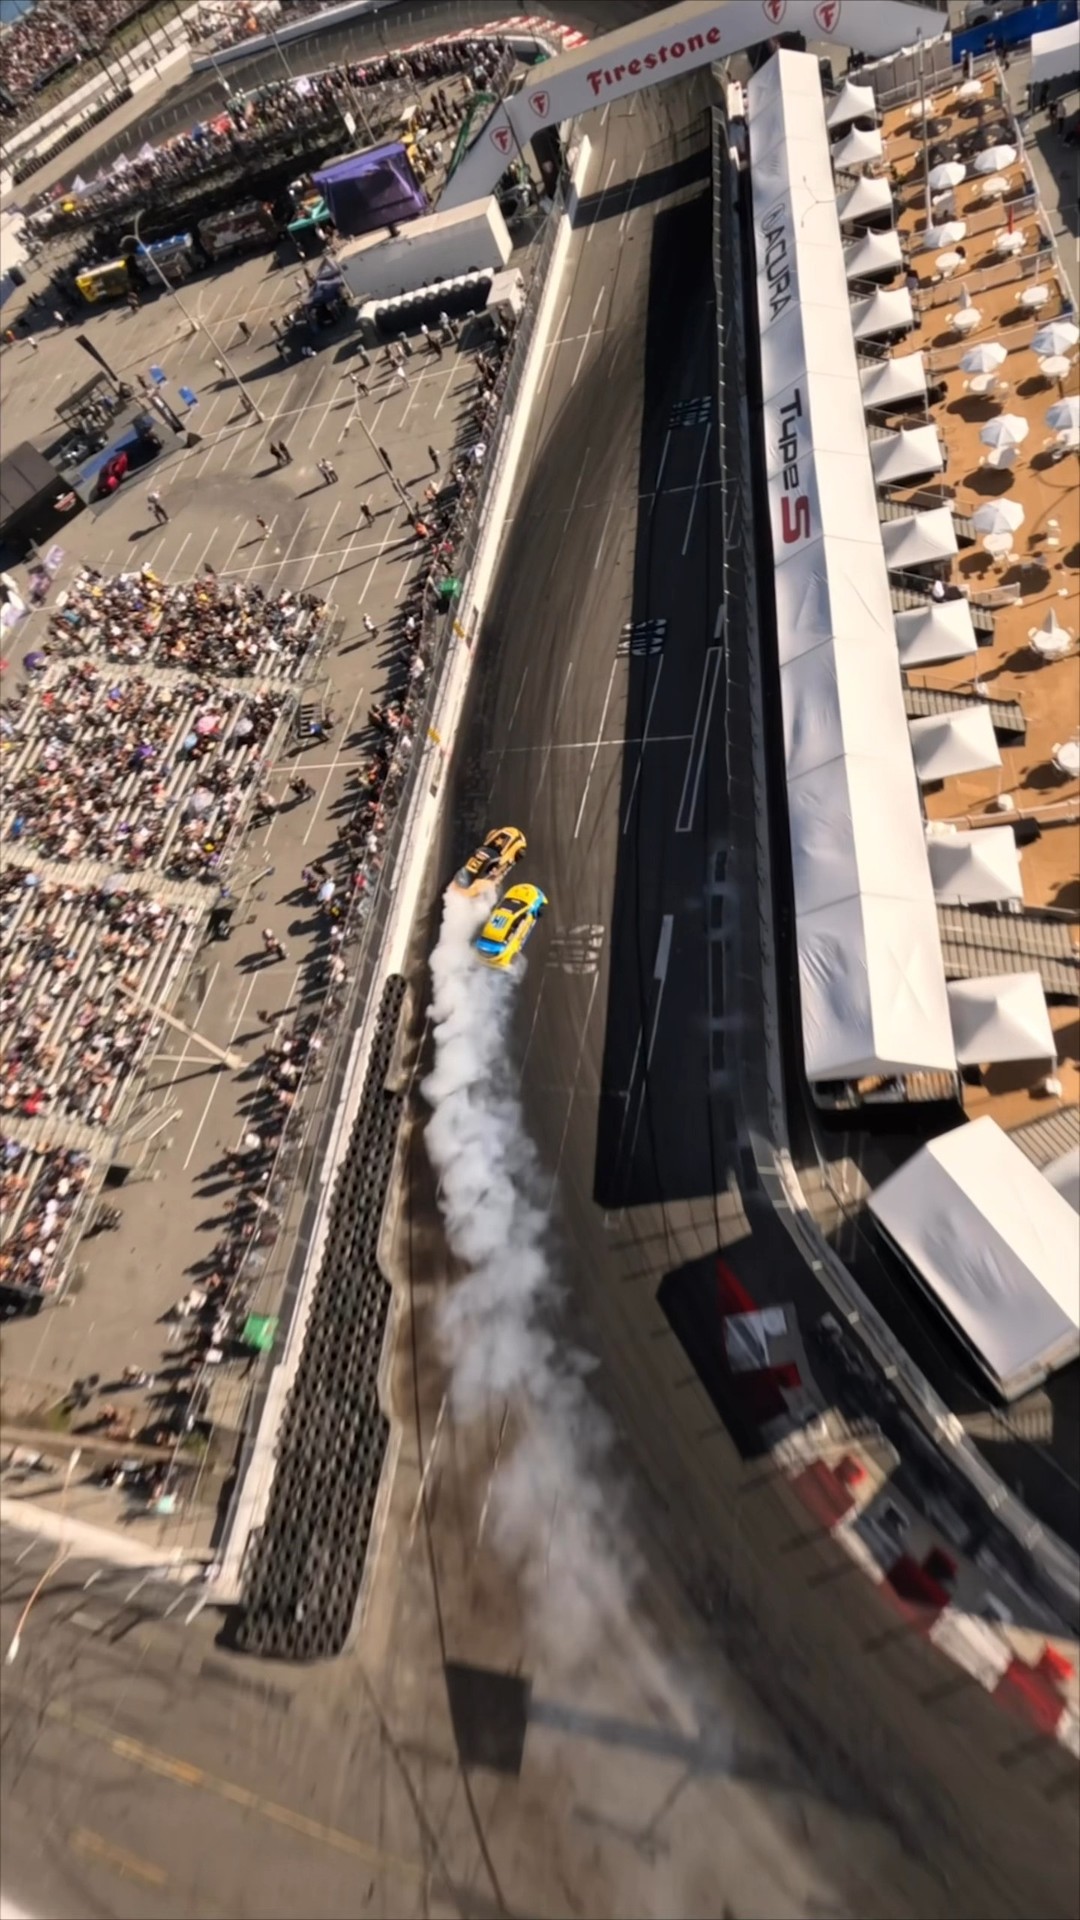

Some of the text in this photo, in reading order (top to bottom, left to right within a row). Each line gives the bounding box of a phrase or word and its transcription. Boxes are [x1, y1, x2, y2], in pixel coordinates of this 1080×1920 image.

[586, 27, 720, 96] Firestone
[764, 225, 792, 322] ACURA
[781, 495, 811, 544] S
